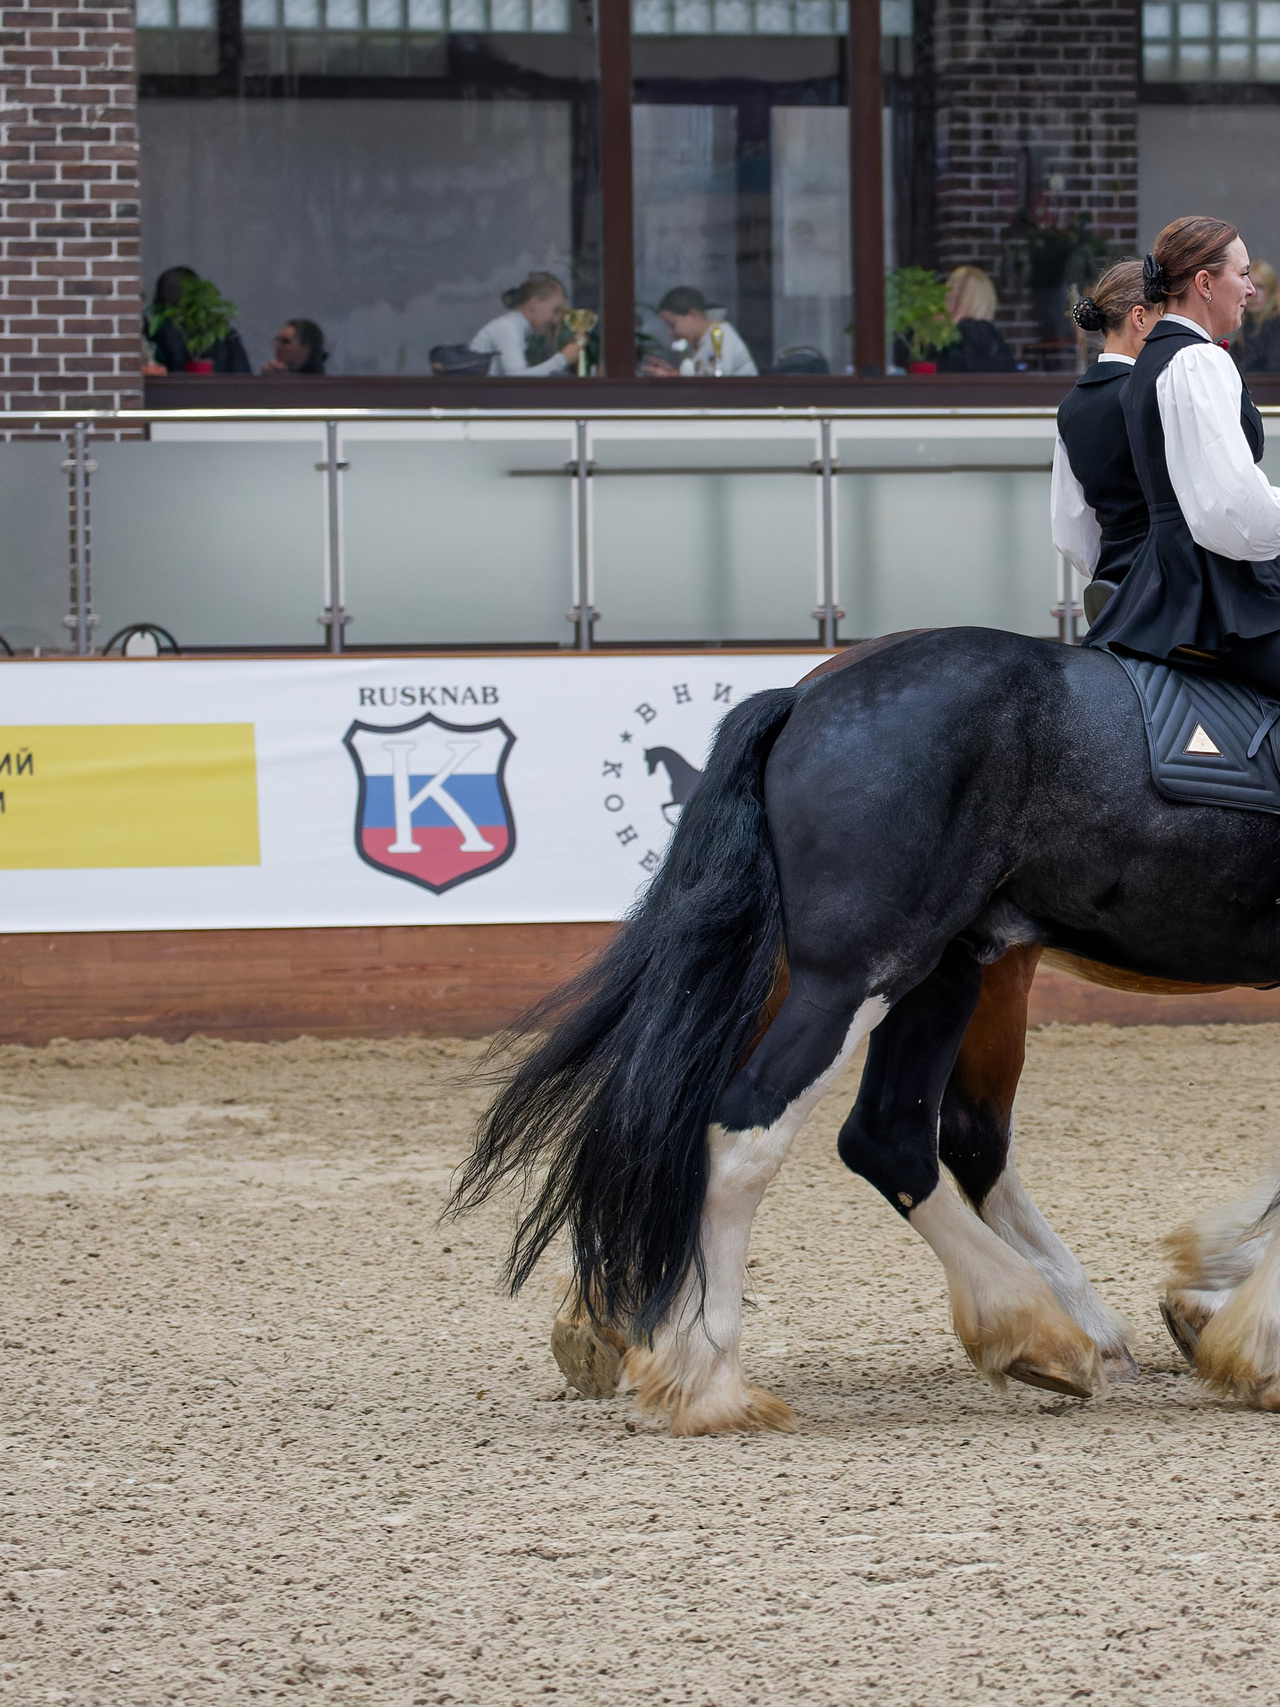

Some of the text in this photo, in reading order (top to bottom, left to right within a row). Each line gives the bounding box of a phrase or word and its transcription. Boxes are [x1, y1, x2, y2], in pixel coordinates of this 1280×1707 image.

[358, 685, 501, 707] RUSKNAB
[634, 682, 733, 725] ВНИ
[0, 747, 33, 776] ИЙ
[381, 740, 495, 854] K
